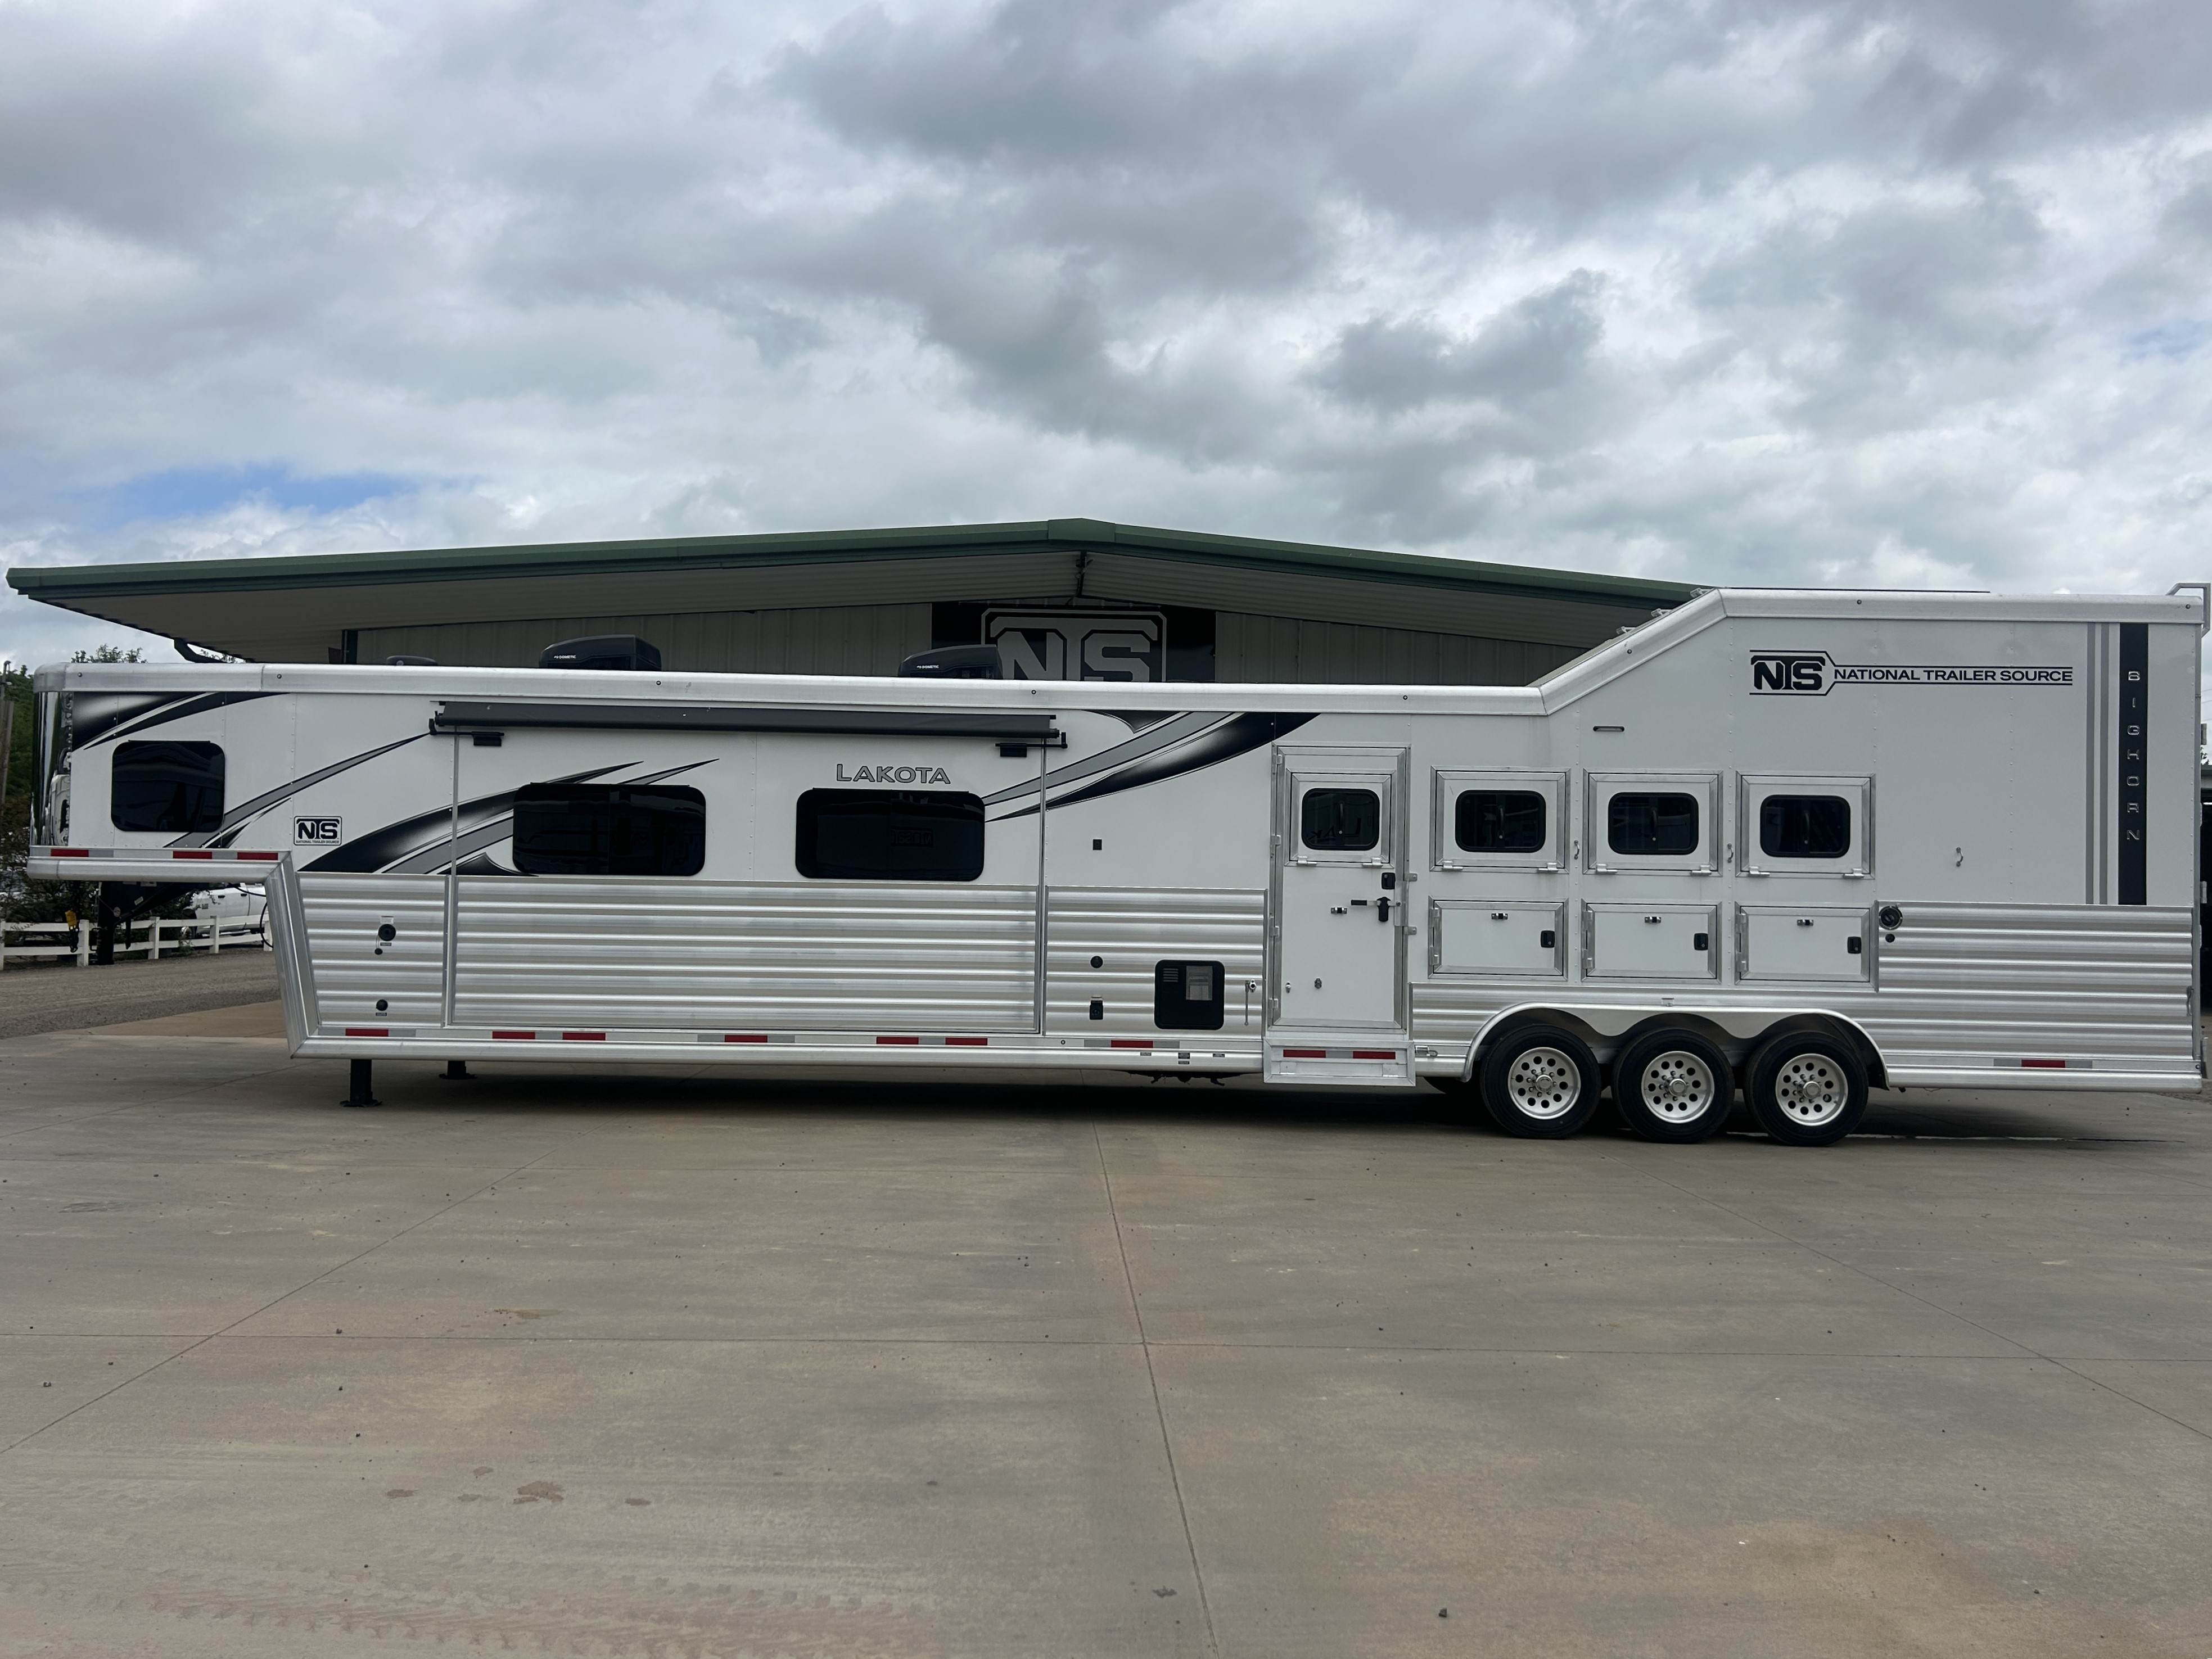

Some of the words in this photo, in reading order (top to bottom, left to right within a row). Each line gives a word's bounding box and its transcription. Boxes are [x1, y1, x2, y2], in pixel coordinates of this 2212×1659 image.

[990, 616, 1158, 681] NTS
[1750, 656, 1826, 690] NTS
[1834, 669, 1920, 680] NATIONAL
[1923, 670, 1997, 681] TRAILER
[1999, 670, 2073, 682] SOURCE
[2127, 671, 2141, 840] BIGHORN
[836, 763, 951, 784] LAKOTA
[296, 819, 340, 839] NTS
